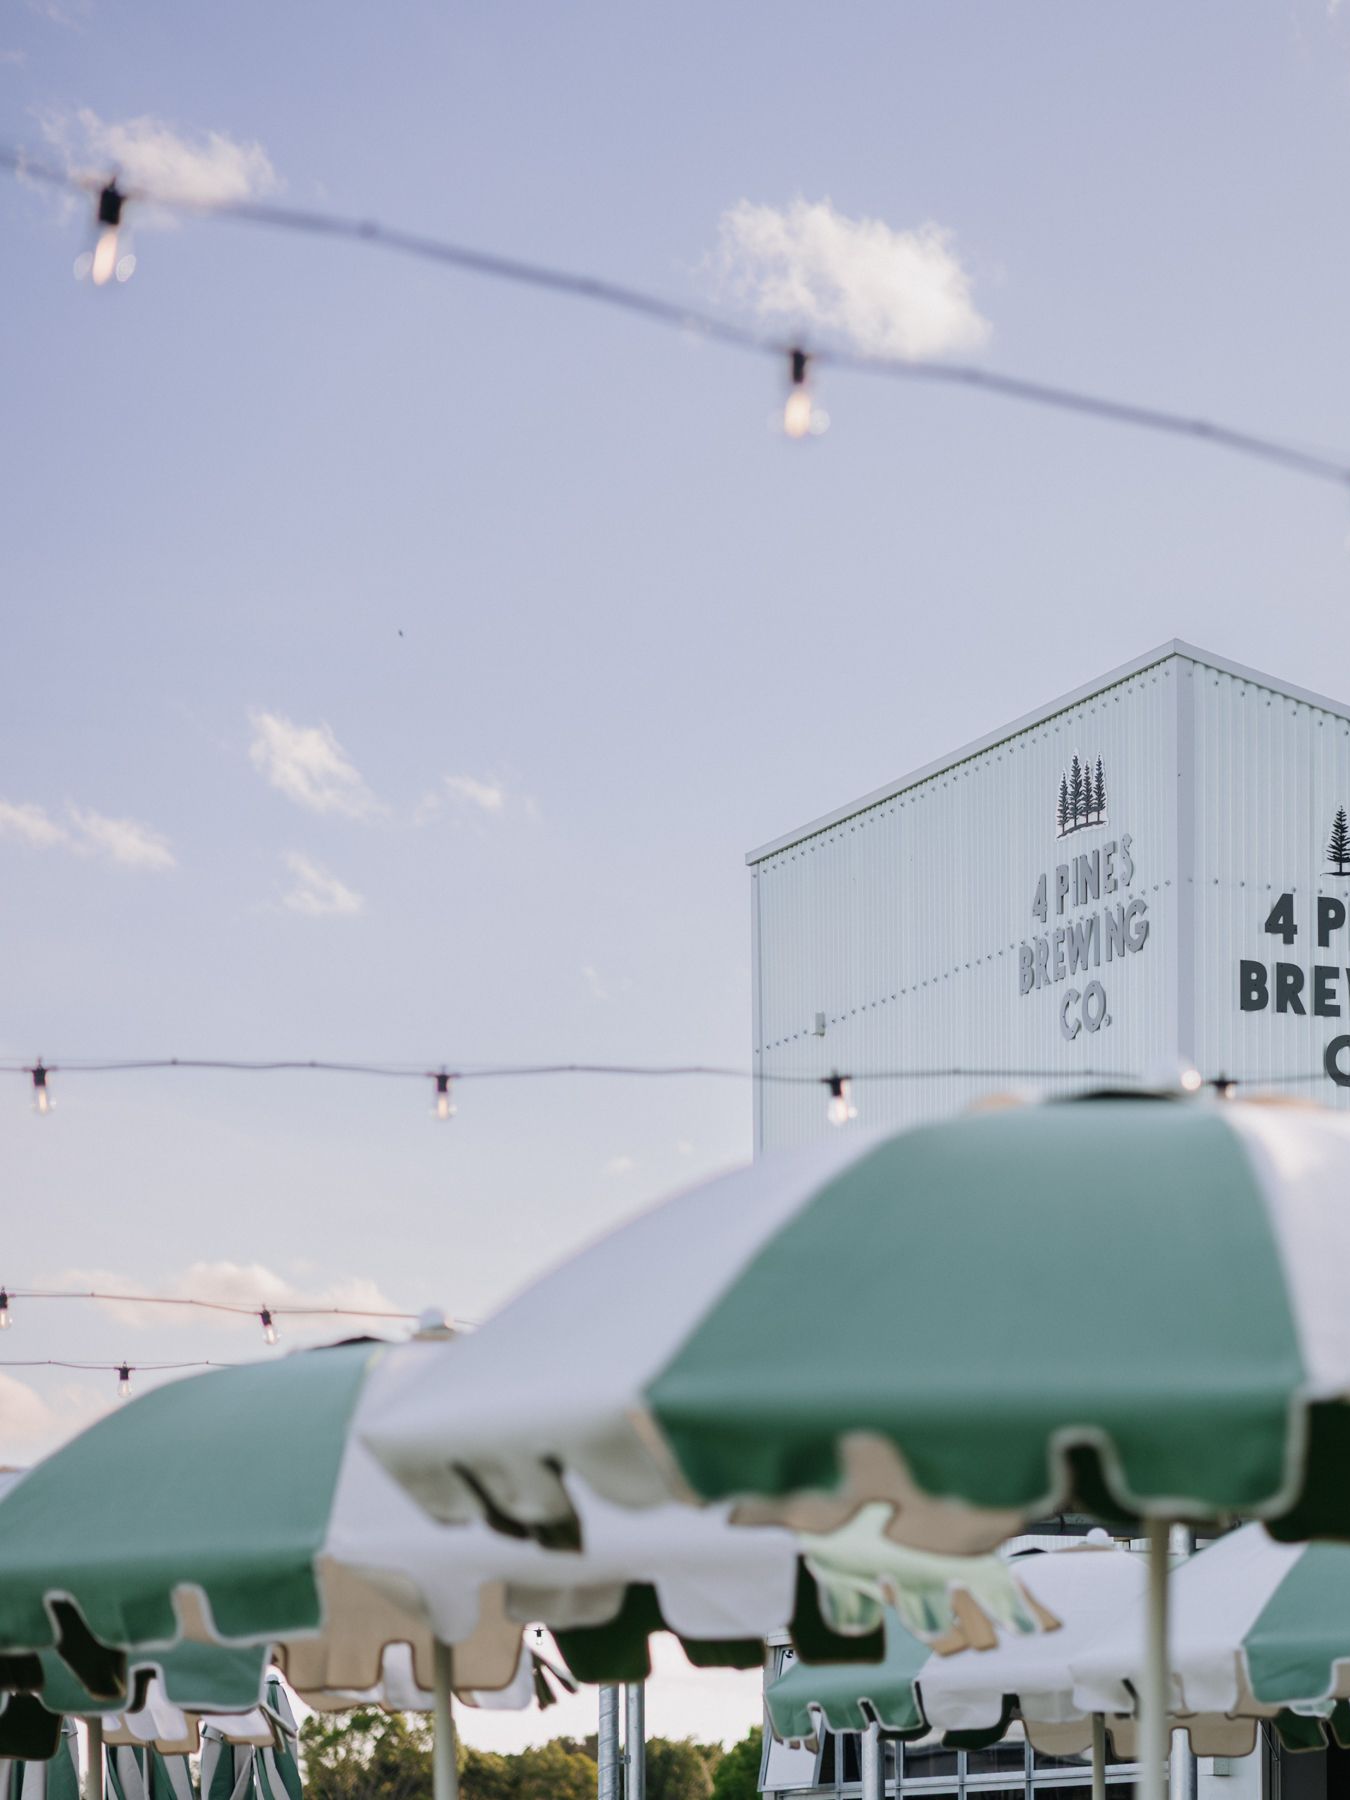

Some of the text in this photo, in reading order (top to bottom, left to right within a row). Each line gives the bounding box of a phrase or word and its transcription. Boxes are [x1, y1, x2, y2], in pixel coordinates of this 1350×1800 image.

[1032, 833, 1133, 922] 4 PINES
[1019, 899, 1149, 995] BREWING
[1264, 893, 1297, 944] 4
[1059, 980, 1112, 1041] CO.
